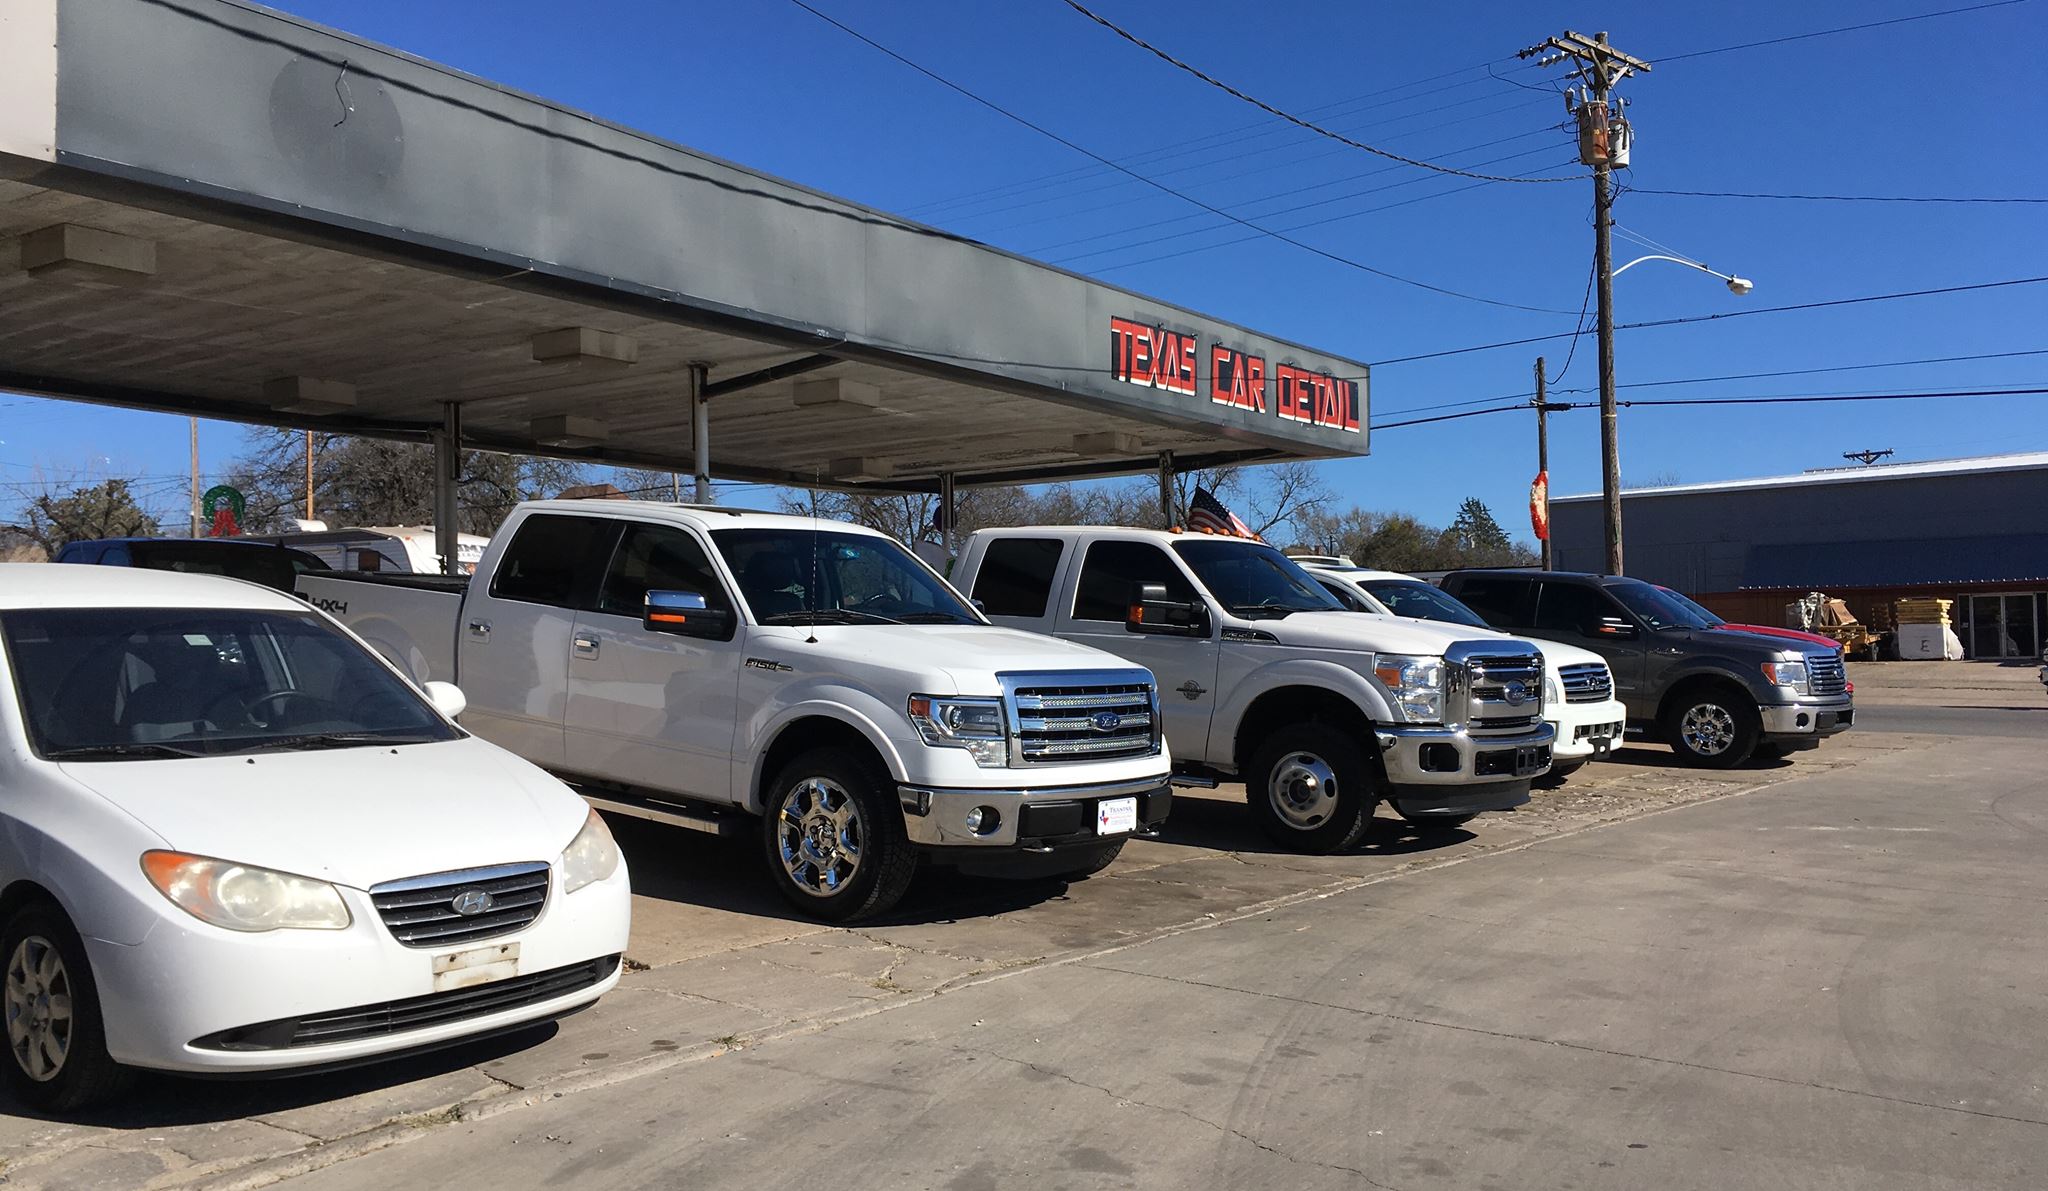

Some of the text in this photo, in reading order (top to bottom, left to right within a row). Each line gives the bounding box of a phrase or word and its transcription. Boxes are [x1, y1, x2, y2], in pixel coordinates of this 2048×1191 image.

[1111, 318, 1360, 434] TEXAS CAR DETAIL
